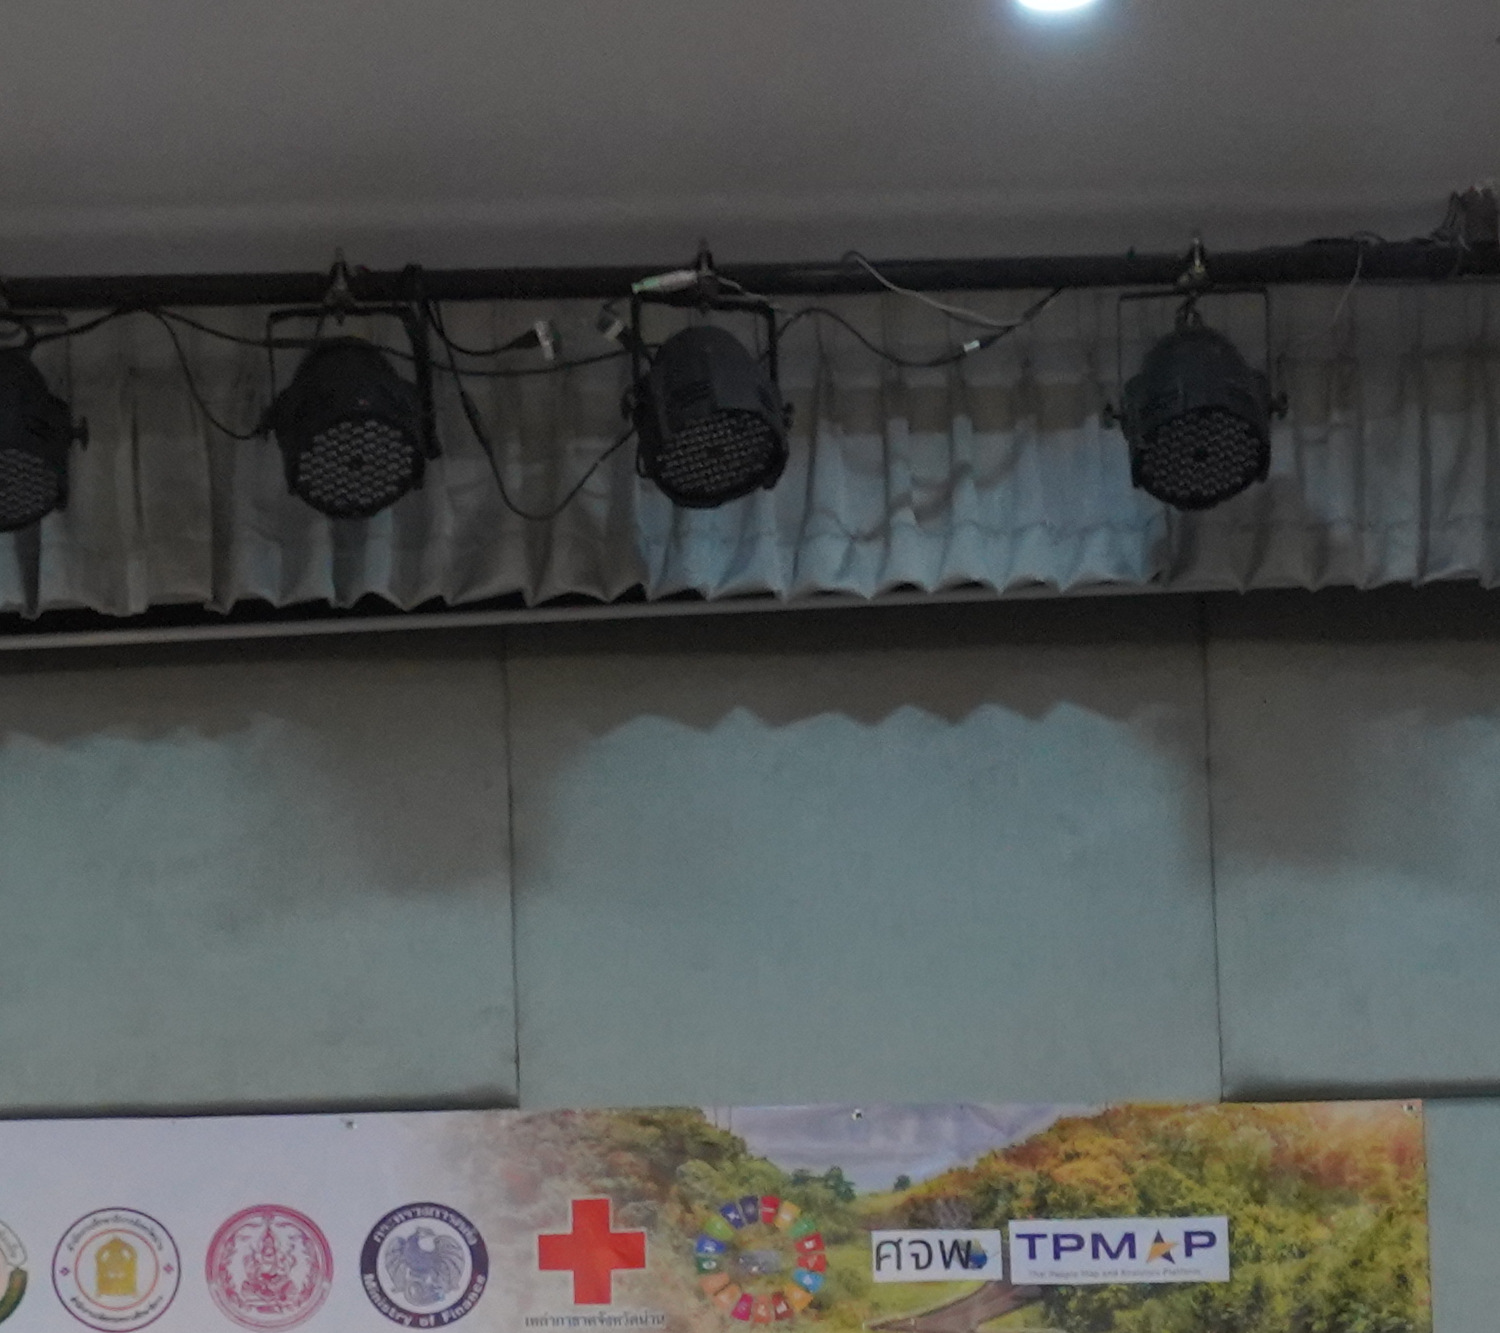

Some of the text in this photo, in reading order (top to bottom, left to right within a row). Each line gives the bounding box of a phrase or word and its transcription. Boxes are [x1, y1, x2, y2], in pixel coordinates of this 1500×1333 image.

[1016, 1230, 1217, 1265] TPMAP
[363, 1273, 412, 1327] Ministry
[419, 1313, 436, 1327] of
[440, 1273, 486, 1323] Finance
